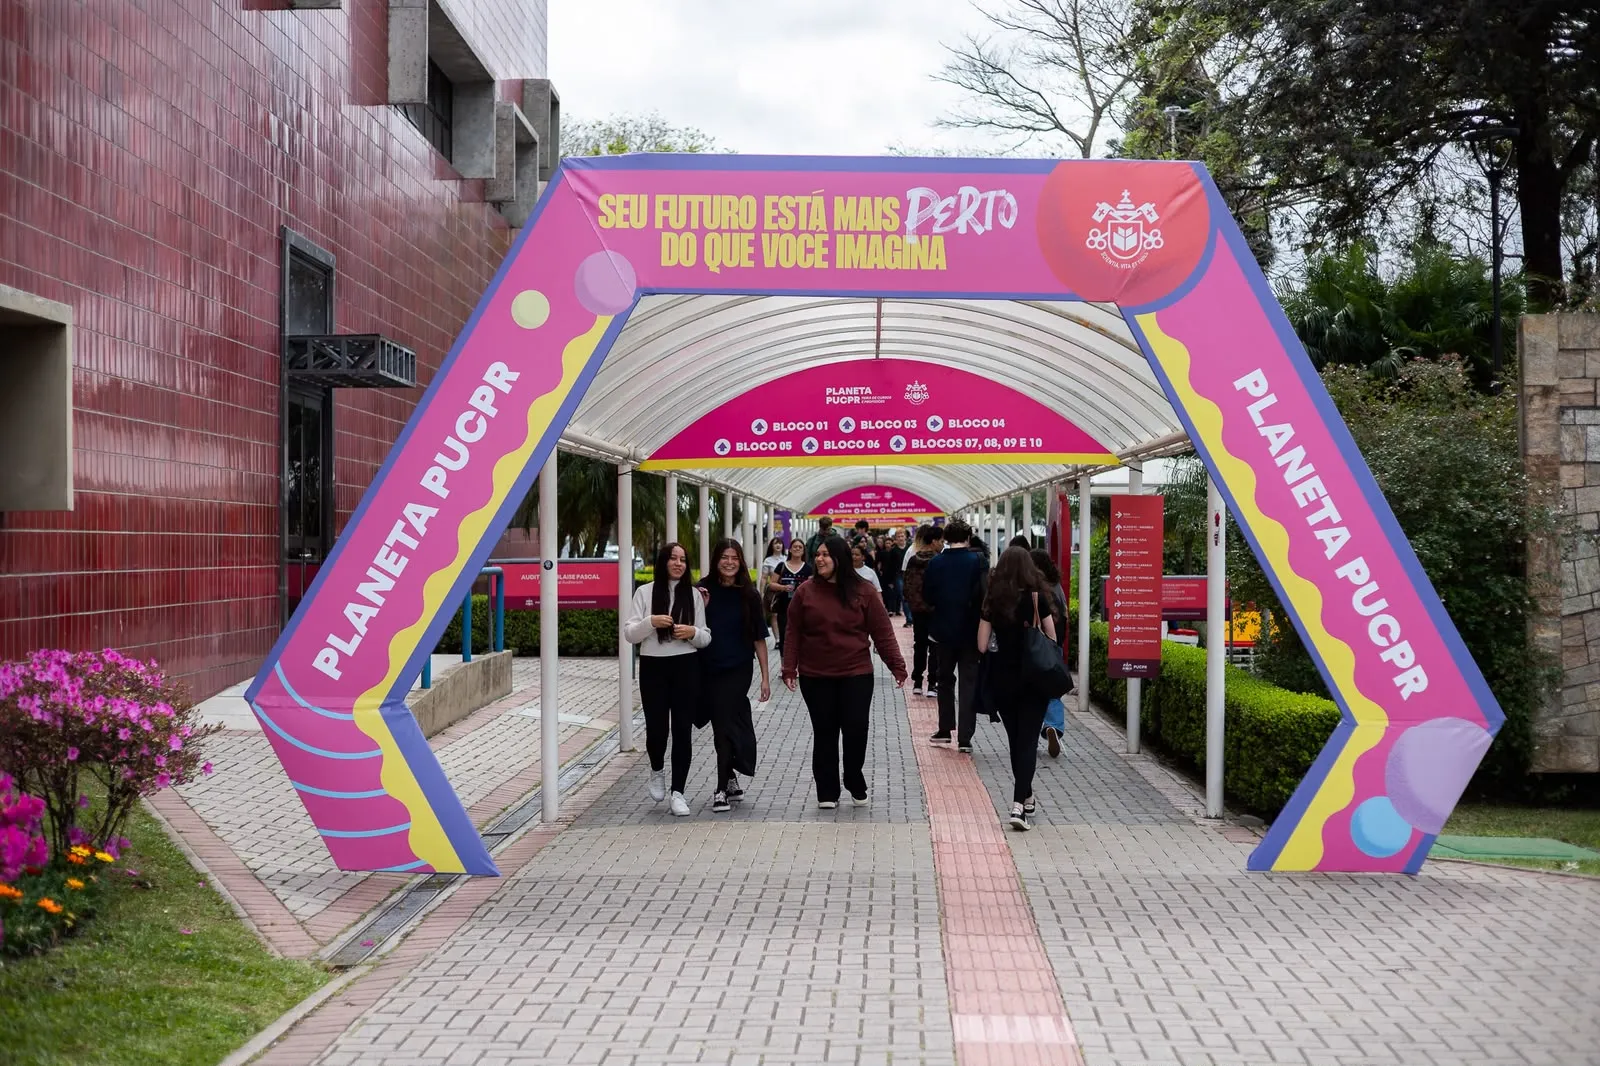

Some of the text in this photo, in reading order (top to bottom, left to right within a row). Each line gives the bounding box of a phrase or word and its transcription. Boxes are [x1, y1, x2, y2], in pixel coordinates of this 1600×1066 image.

[598, 185, 1018, 244] SEU FUTURO ESTÁ MAIS PERTO
[660, 231, 697, 267] DO
[703, 232, 755, 274] QUE
[835, 233, 947, 270] IMAGINA
[826, 387, 872, 395] PLANETA
[826, 396, 860, 404] PUCPR
[773, 421, 828, 431] BLOCO 01
[860, 420, 917, 430] BLOCO 03
[948, 419, 1005, 428] BLOCO 04
[736, 441, 792, 451] BLOCO 05
[823, 440, 880, 450] BLOCO 06
[911, 438, 1042, 450] BLOCOS 07, 08, 09 E 10
[311, 361, 520, 681] PLANETA PUCPR
[1233, 368, 1429, 701] PLANETA PUCPR
